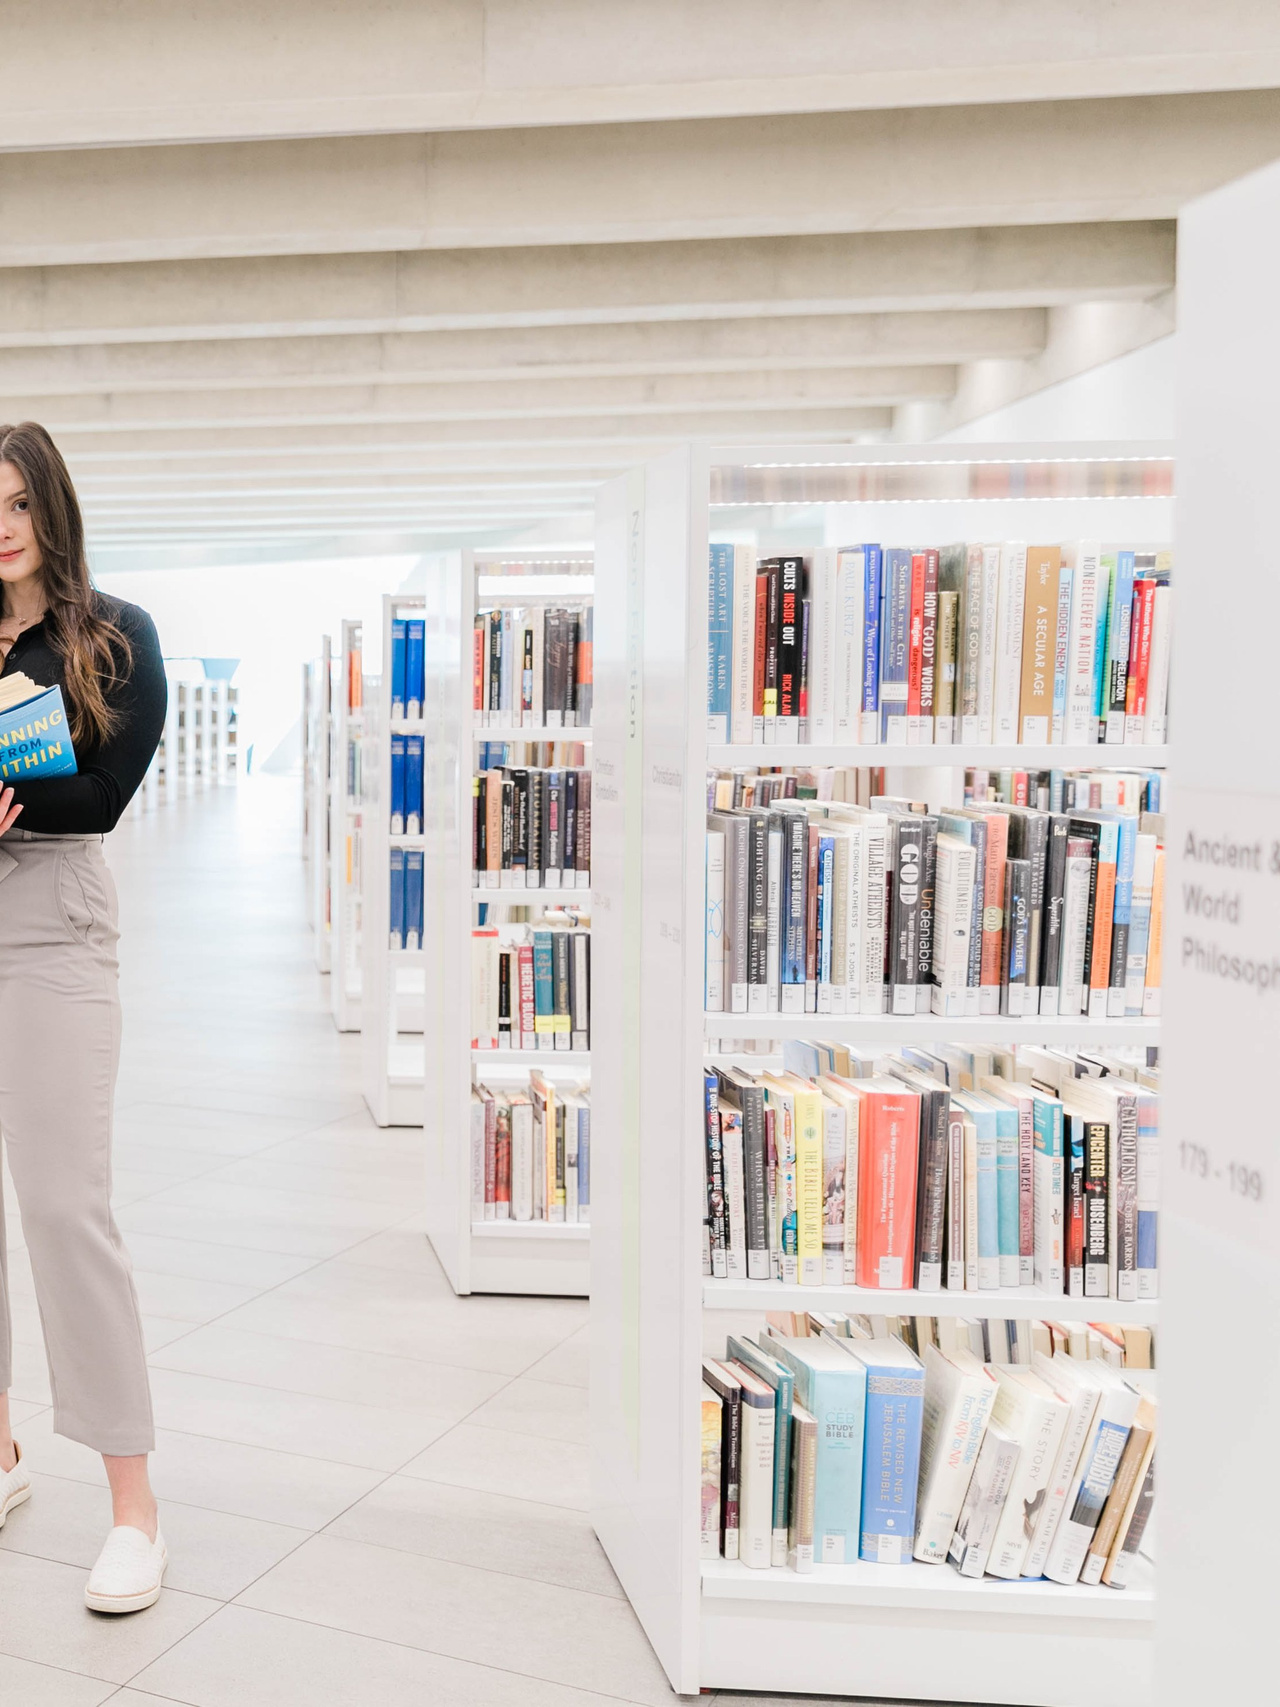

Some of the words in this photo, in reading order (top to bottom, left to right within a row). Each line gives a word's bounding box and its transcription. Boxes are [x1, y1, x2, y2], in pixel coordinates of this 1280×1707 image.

[988, 554, 996, 570] The
[1037, 561, 1051, 585] Taylor
[783, 562, 796, 590] CULTS
[844, 562, 855, 592] PAUL
[971, 567, 980, 586] THE
[987, 572, 996, 604] Secular
[924, 592, 936, 617] HOW
[971, 589, 980, 612] FACE
[1060, 581, 1070, 601] THE
[1080, 556, 1097, 629] NONBELIEVER
[782, 592, 795, 624] INSIDE
[843, 596, 855, 636] KURTZ
[1037, 605, 1048, 614] A
[1058, 602, 1069, 639] HIDDEN
[1119, 604, 1130, 636] LOSING
[782, 626, 795, 646] OUT
[970, 616, 979, 630] OF
[985, 607, 995, 656] Conscience
[969, 632, 979, 657] GOD
[1034, 618, 1048, 668] SECULAR
[1077, 635, 1092, 674] NATION
[1118, 639, 1128, 659] OUR
[1055, 641, 1067, 675] ENEMY
[717, 655, 726, 690] KAREN
[782, 674, 793, 691] RICK
[1033, 672, 1045, 696] AGE
[1116, 660, 1127, 701] RELIGION
[921, 667, 933, 707] WORKS
[781, 694, 792, 715] ALAN
[790, 822, 803, 851] IMAGINE
[755, 831, 764, 881] FIGHTING
[867, 837, 884, 879] VILLAGE
[1182, 830, 1262, 873] Ancient
[791, 852, 802, 879] THERE'S
[899, 843, 920, 905] GOD
[755, 884, 763, 907] GOD
[791, 881, 801, 891] NO
[954, 851, 972, 923] EVOLUTIONARIES
[790, 892, 801, 918] HEAVEN
[866, 881, 883, 929] ATHEISTS
[1016, 898, 1026, 926] GOD'S
[1182, 881, 1241, 925] World
[918, 888, 933, 972] Undeniable
[758, 950, 766, 975] DAVID
[1014, 929, 1025, 970] UNIVERSE
[523, 1003, 533, 1031] BLOOD
[1021, 1111, 1032, 1126] THE
[1021, 1129, 1031, 1149] HOLY
[1090, 1125, 1105, 1177] EPICENTER
[1121, 1106, 1137, 1185] CATHOLICISM
[804, 1150, 817, 1165] THE
[1021, 1152, 1031, 1175] LAND
[804, 1168, 818, 1193] BIBLE
[1021, 1177, 1031, 1193] KEY
[1071, 1171, 1082, 1197] Target
[1179, 1139, 1210, 1180] 179
[1227, 1160, 1264, 1204] 199
[804, 1197, 818, 1220] TELLS
[1073, 1197, 1082, 1218] Israel
[1124, 1201, 1133, 1233] ROBERT
[804, 1223, 817, 1237] ME
[1089, 1198, 1105, 1255] ROSENBERG
[804, 1239, 817, 1250] SO
[1123, 1236, 1133, 1271] BARRON
[958, 1395, 976, 1420] From
[978, 1388, 994, 1406] The
[825, 1410, 855, 1424] CEB
[897, 1403, 907, 1424] THE
[970, 1407, 991, 1442] English
[1041, 1410, 1057, 1435] THE
[825, 1431, 854, 1439] BIBLE
[881, 1402, 893, 1467] JERUSALEM
[953, 1420, 972, 1439] KJV
[1104, 1428, 1127, 1455] HOPE
[894, 1428, 906, 1475] REVISED
[953, 1439, 964, 1449] to
[962, 1442, 978, 1465] Bible
[947, 1449, 962, 1469] NIV
[1028, 1439, 1048, 1481] STORY
[880, 1470, 891, 1501] BIBLE
[1085, 1454, 1118, 1492] BIBLE
[893, 1478, 904, 1504] NEW
